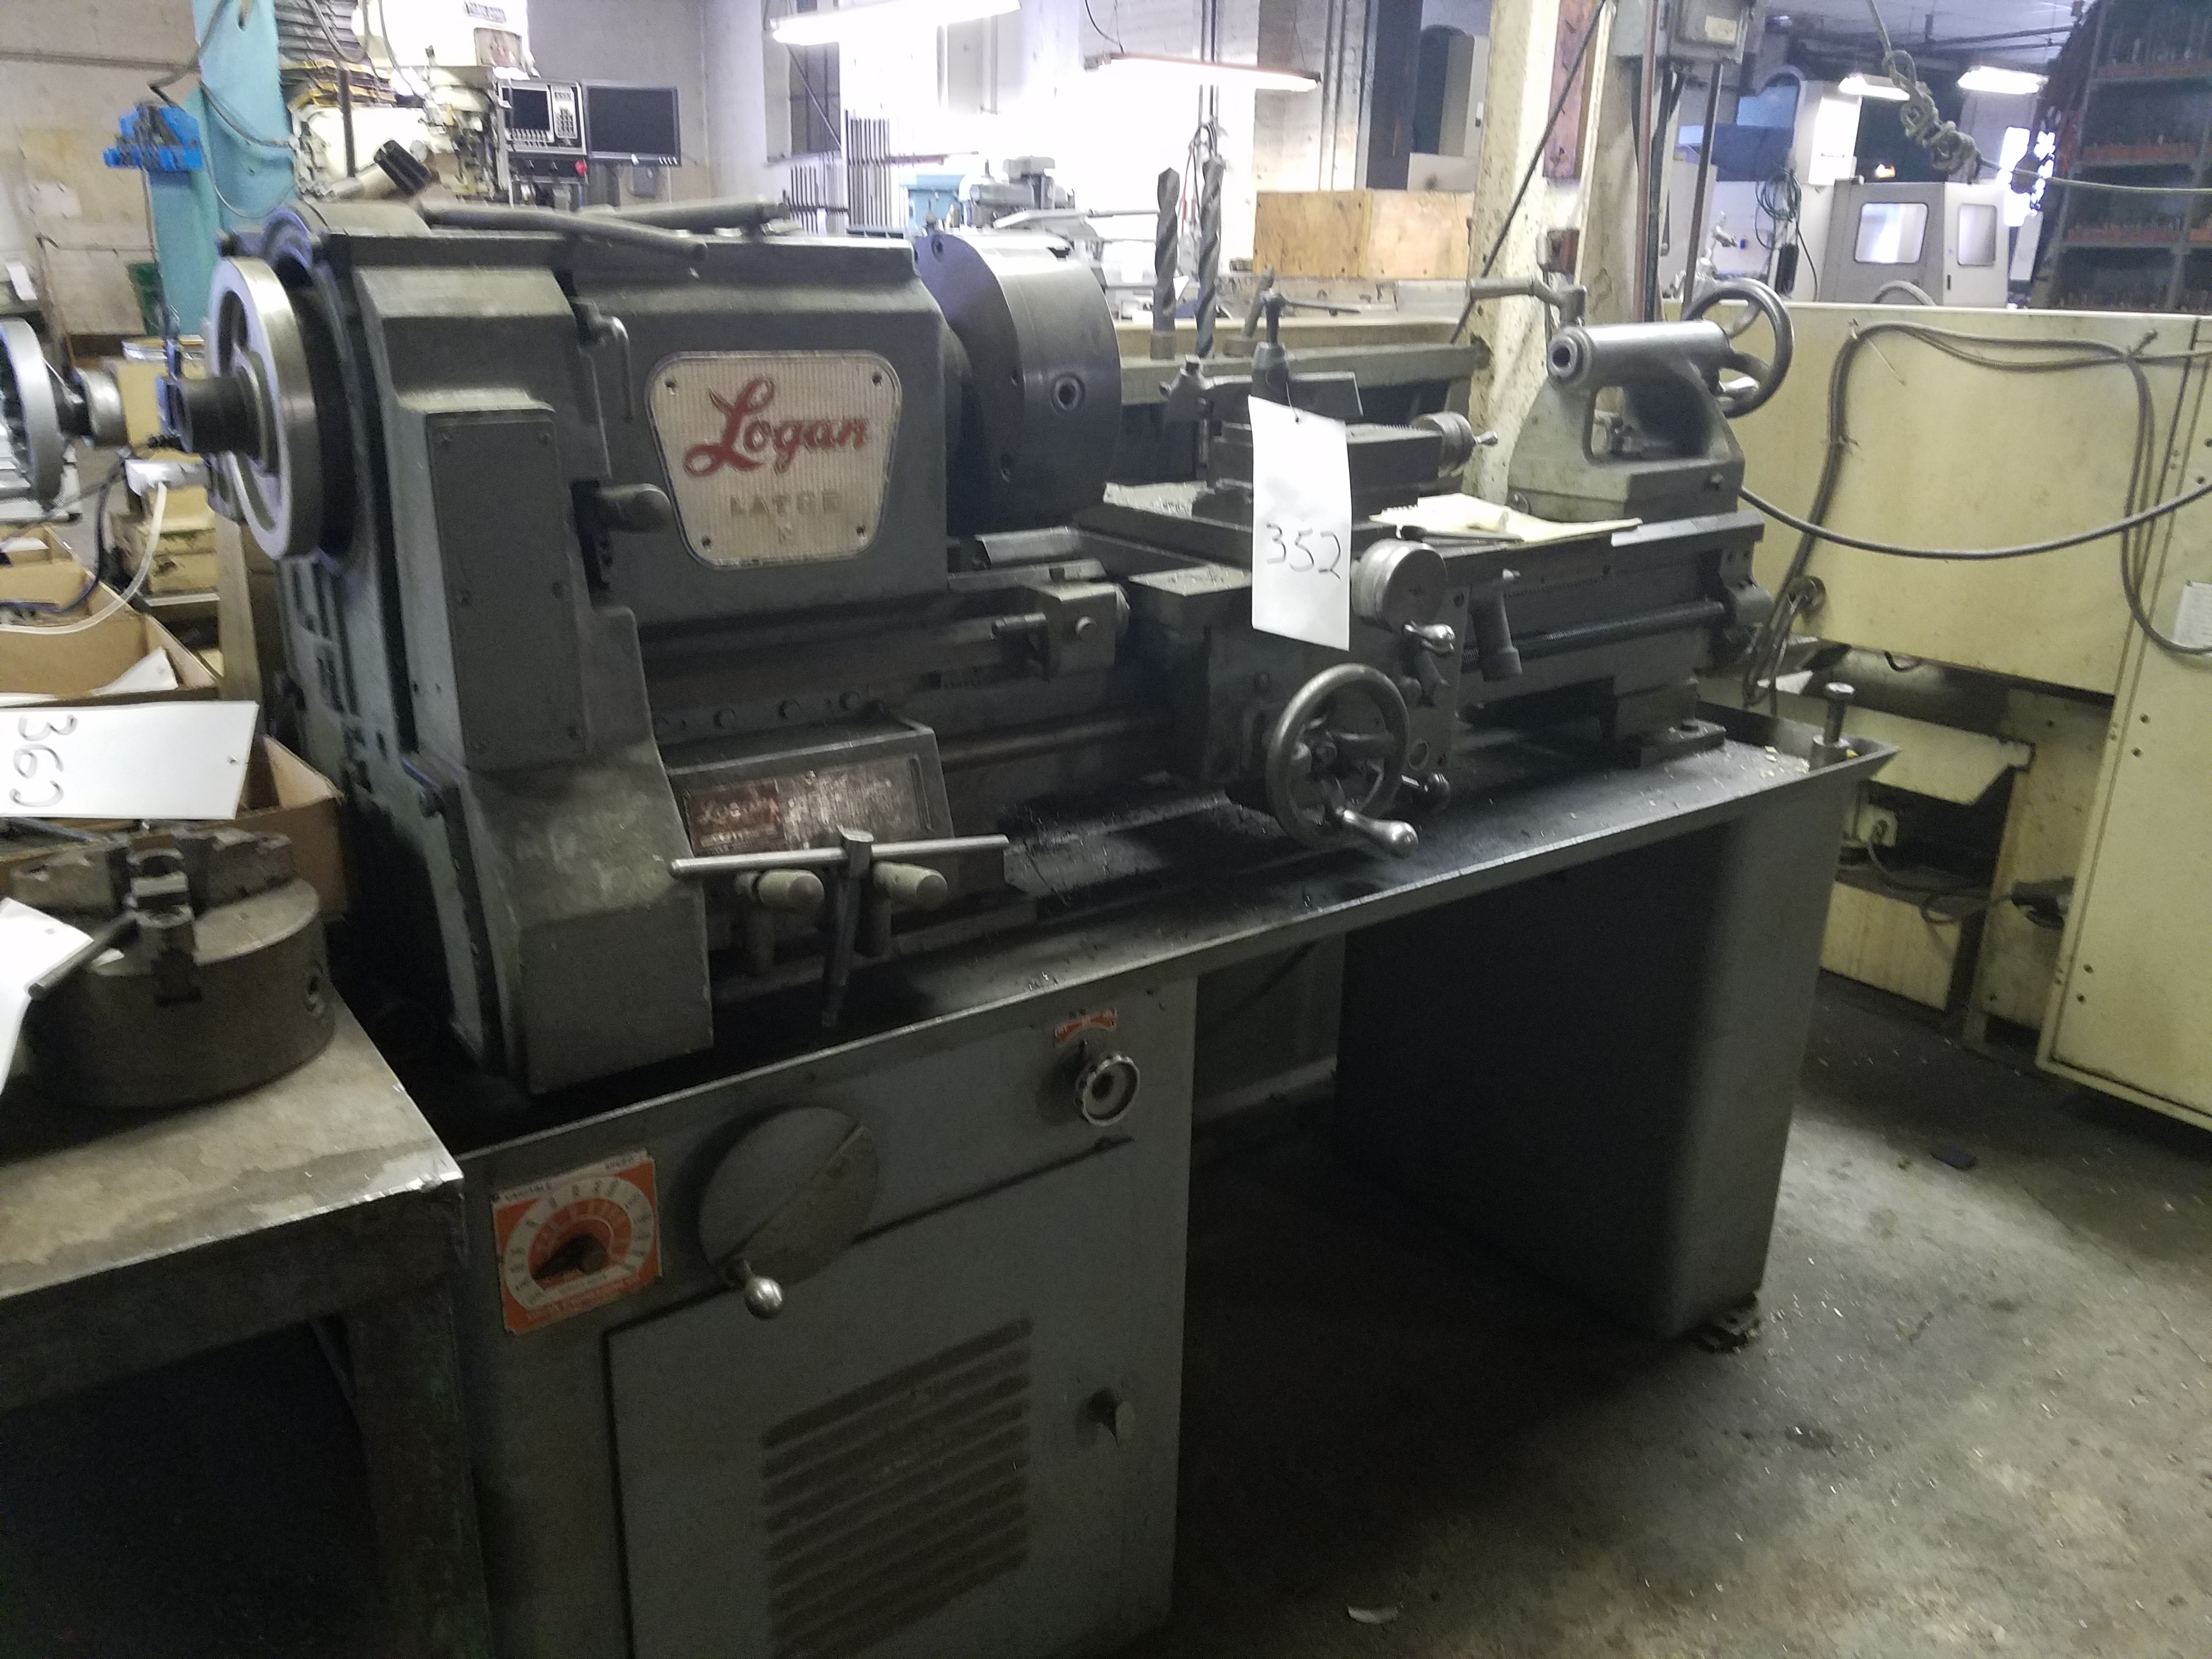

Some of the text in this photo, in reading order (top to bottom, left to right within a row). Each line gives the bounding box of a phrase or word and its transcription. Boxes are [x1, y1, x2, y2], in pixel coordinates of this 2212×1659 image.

[683, 376, 868, 476] Logan
[1266, 523, 1341, 580] 352
[9, 714, 78, 807] 362
